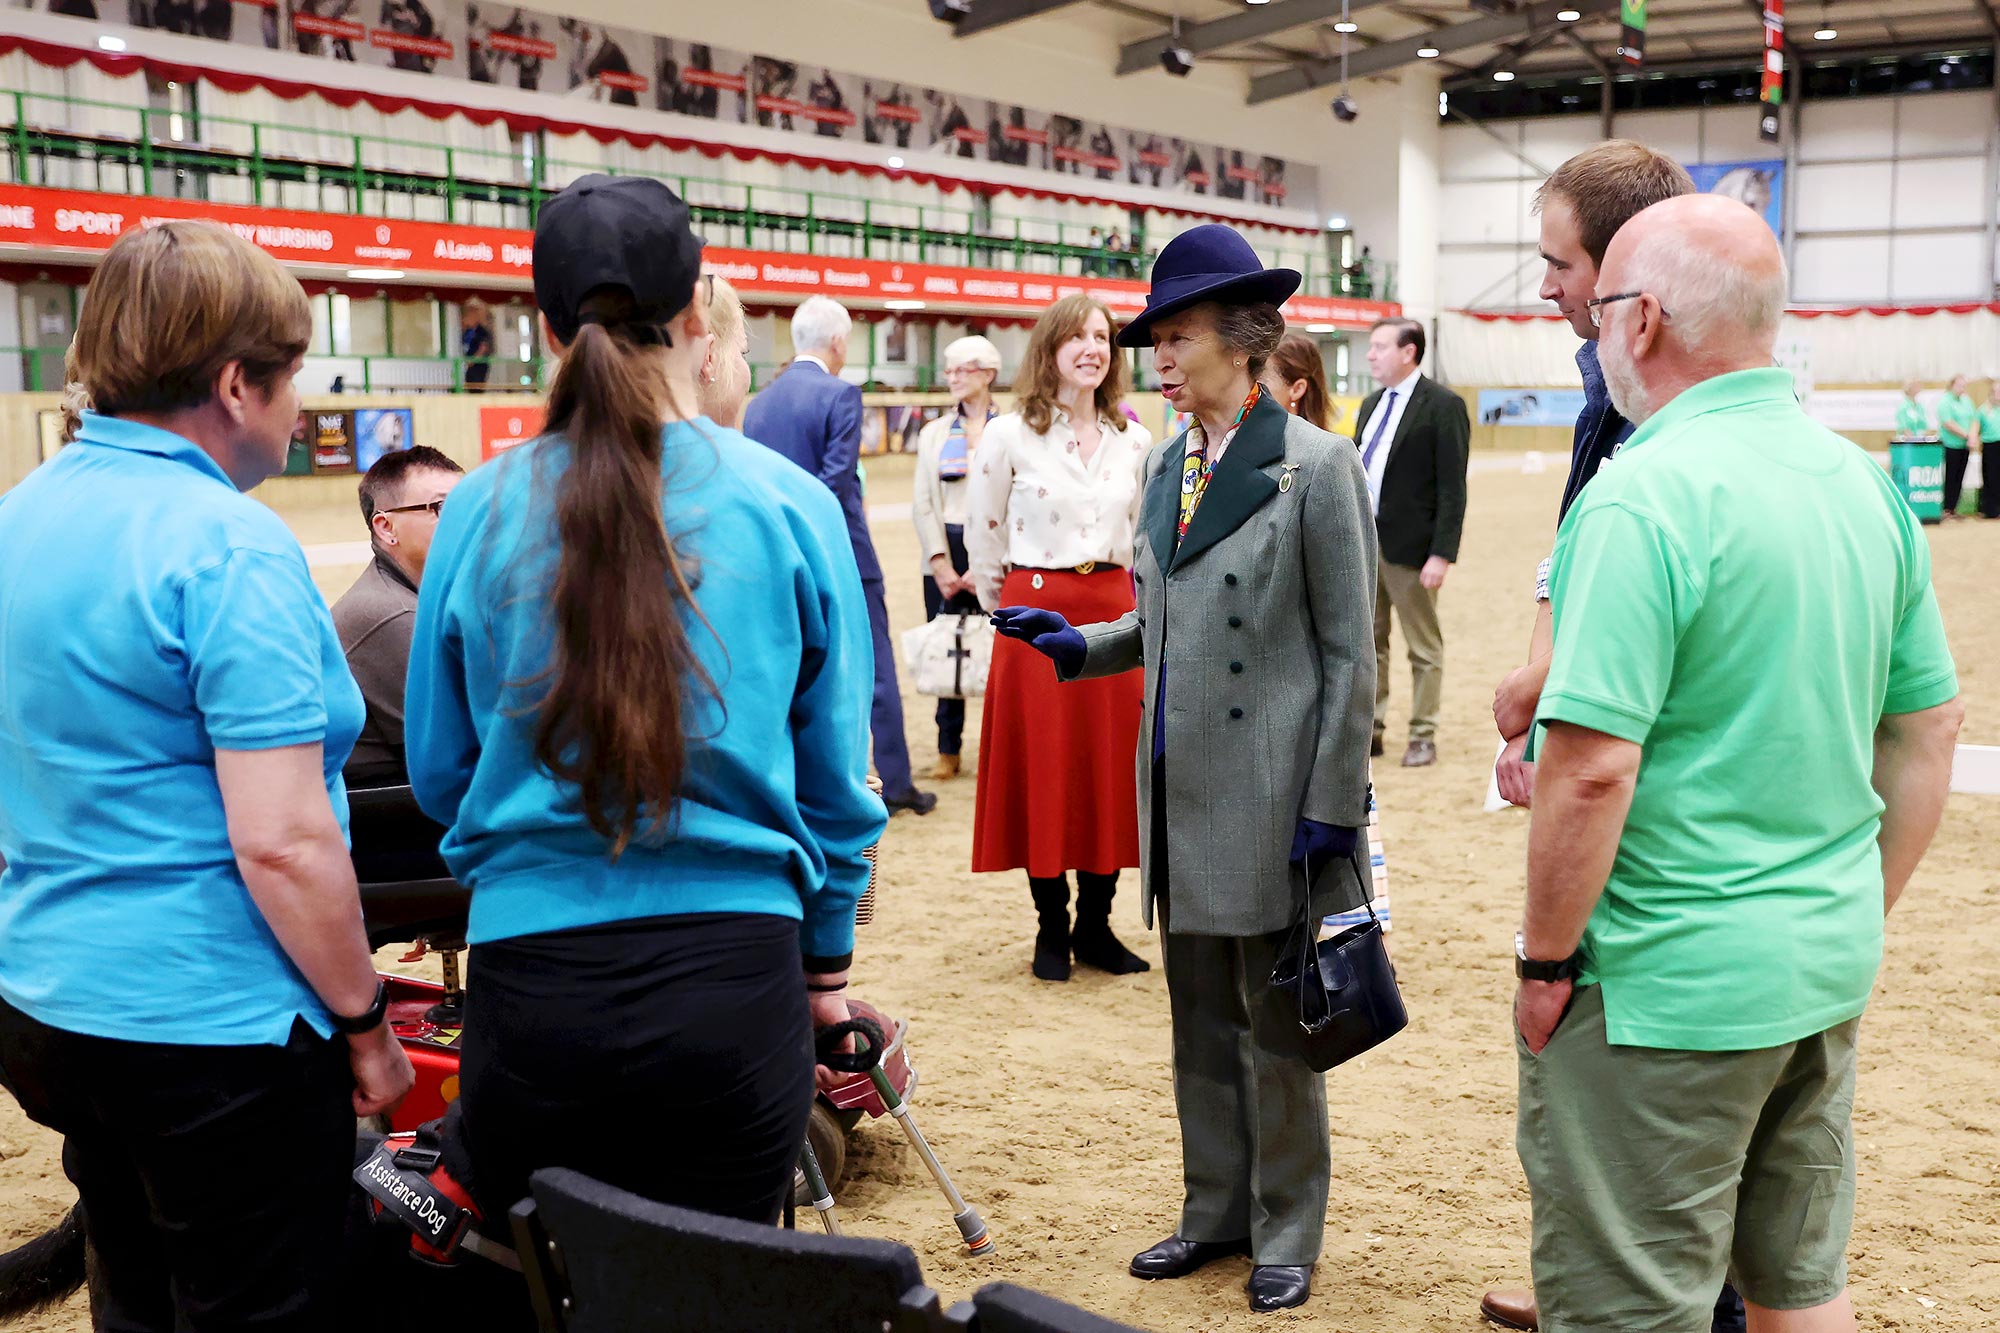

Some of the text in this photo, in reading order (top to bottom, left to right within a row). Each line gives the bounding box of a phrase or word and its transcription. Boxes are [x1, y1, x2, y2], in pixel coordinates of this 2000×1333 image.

[55, 209, 124, 235] SPORT
[256, 225, 333, 251] NURSING
[362, 1156, 447, 1235] Assistance Dog
